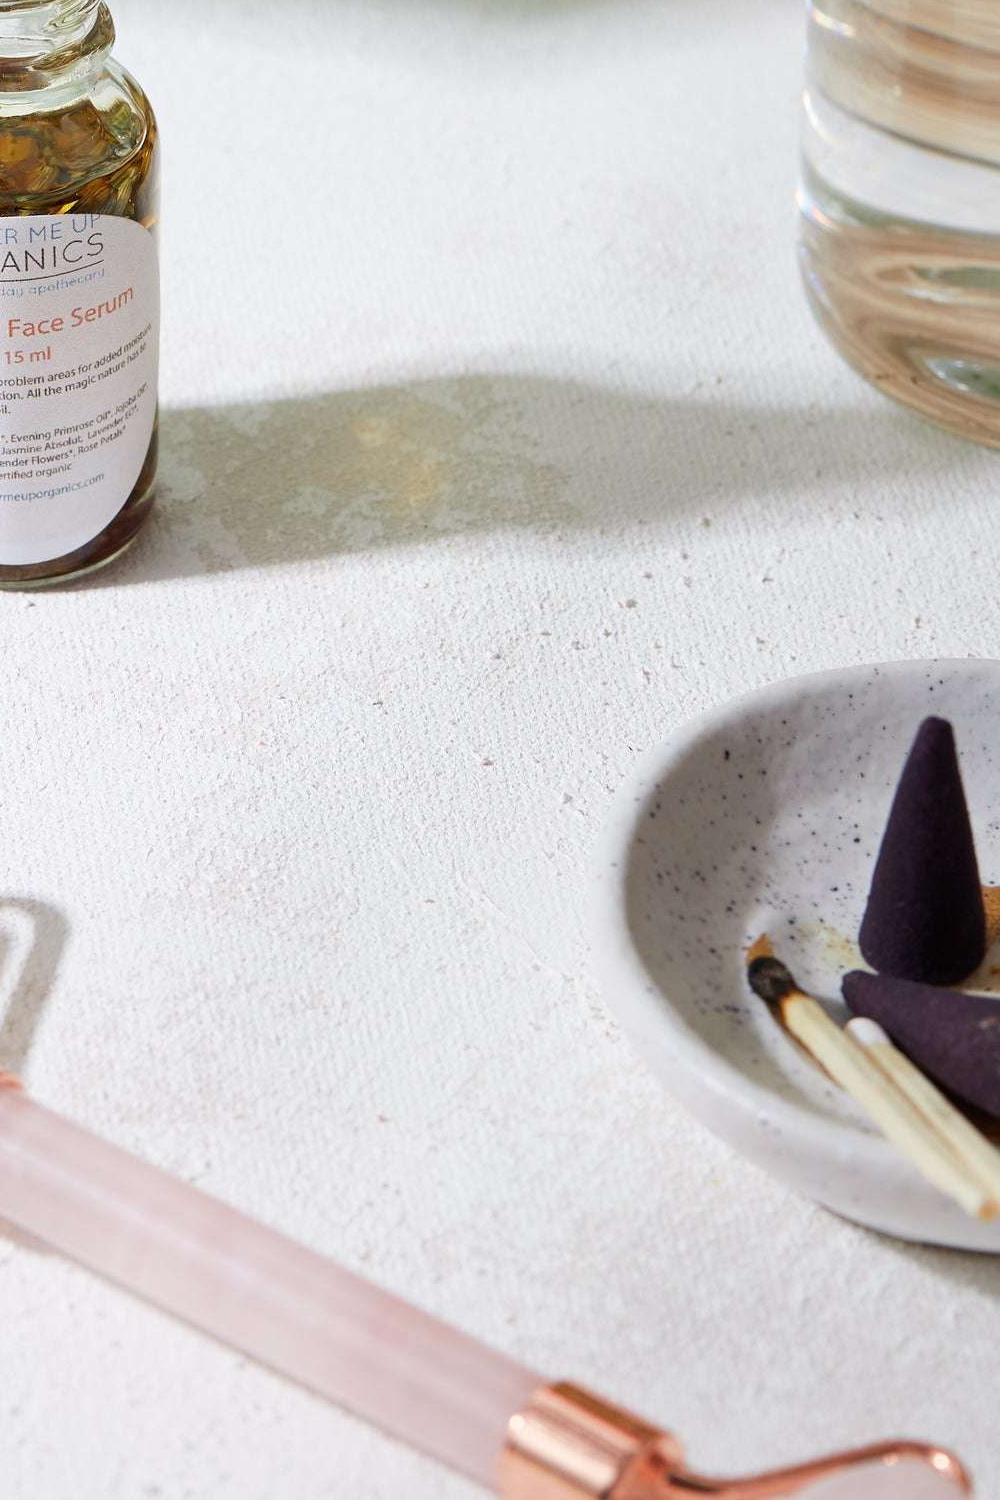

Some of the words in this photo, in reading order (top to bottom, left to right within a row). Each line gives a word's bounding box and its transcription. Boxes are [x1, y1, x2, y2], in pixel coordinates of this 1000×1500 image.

[29, 222, 63, 243] ME
[71, 214, 101, 233] UP
[28, 268, 105, 296] apothecary
[7, 318, 64, 338] Face
[71, 286, 135, 328] Serum
[4, 350, 24, 365] 15
[29, 346, 51, 362] ml
[47, 369, 76, 382] areas
[78, 363, 93, 374] for
[94, 346, 122, 369] added
[27, 388, 41, 398] All
[44, 386, 62, 396] the
[65, 375, 96, 392] magic
[98, 360, 126, 380] nature
[127, 350, 139, 363] has
[1, 445, 41, 455] Jasmine
[87, 417, 124, 439] Lavender
[11, 432, 52, 443] Evening
[54, 420, 95, 436] Primrose
[78, 442, 98, 454] Rose
[35, 463, 72, 477] organic
